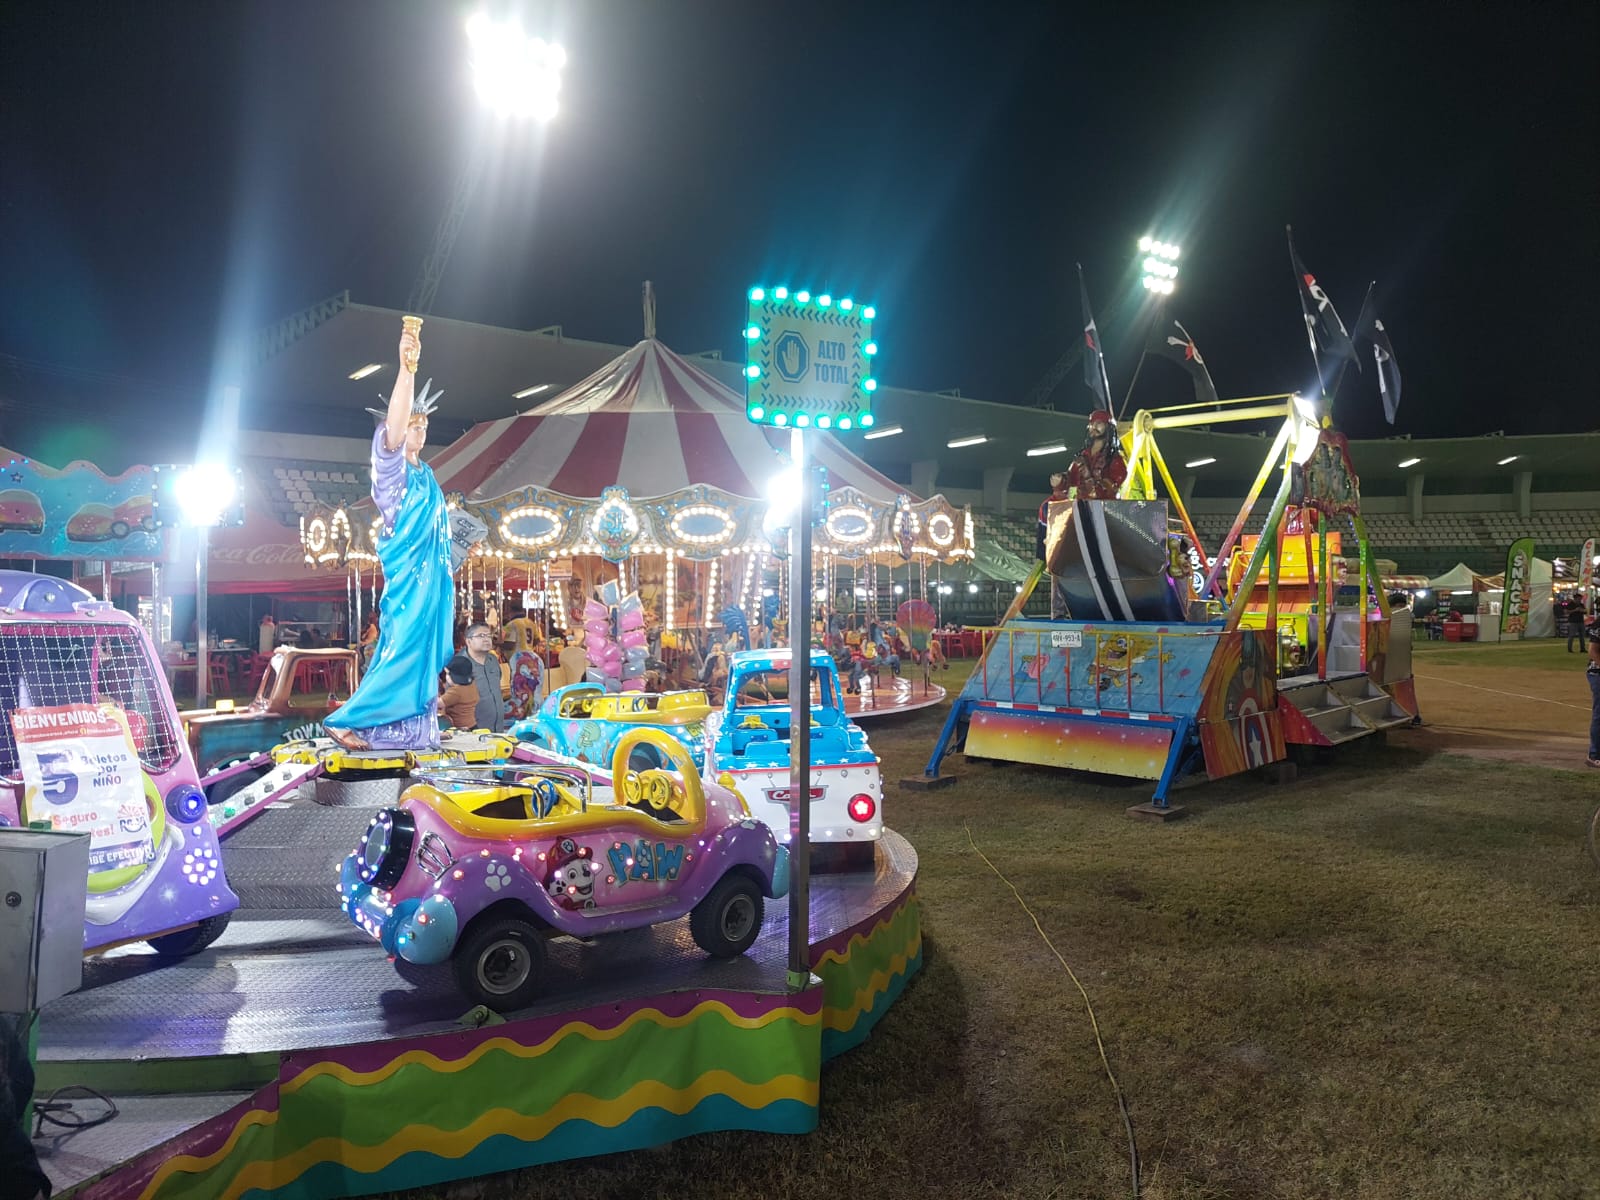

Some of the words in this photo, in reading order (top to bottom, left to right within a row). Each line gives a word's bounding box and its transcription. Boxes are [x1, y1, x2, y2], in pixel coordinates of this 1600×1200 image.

[818, 340, 846, 361] ALTO
[814, 363, 849, 385] TOTAL
[1509, 555, 1524, 615] SNACK
[14, 709, 107, 729] BIENVENIDOS
[36, 752, 79, 806] 5
[93, 774, 122, 787] NIÑO
[97, 765, 118, 777] por
[607, 839, 685, 888] PAW
